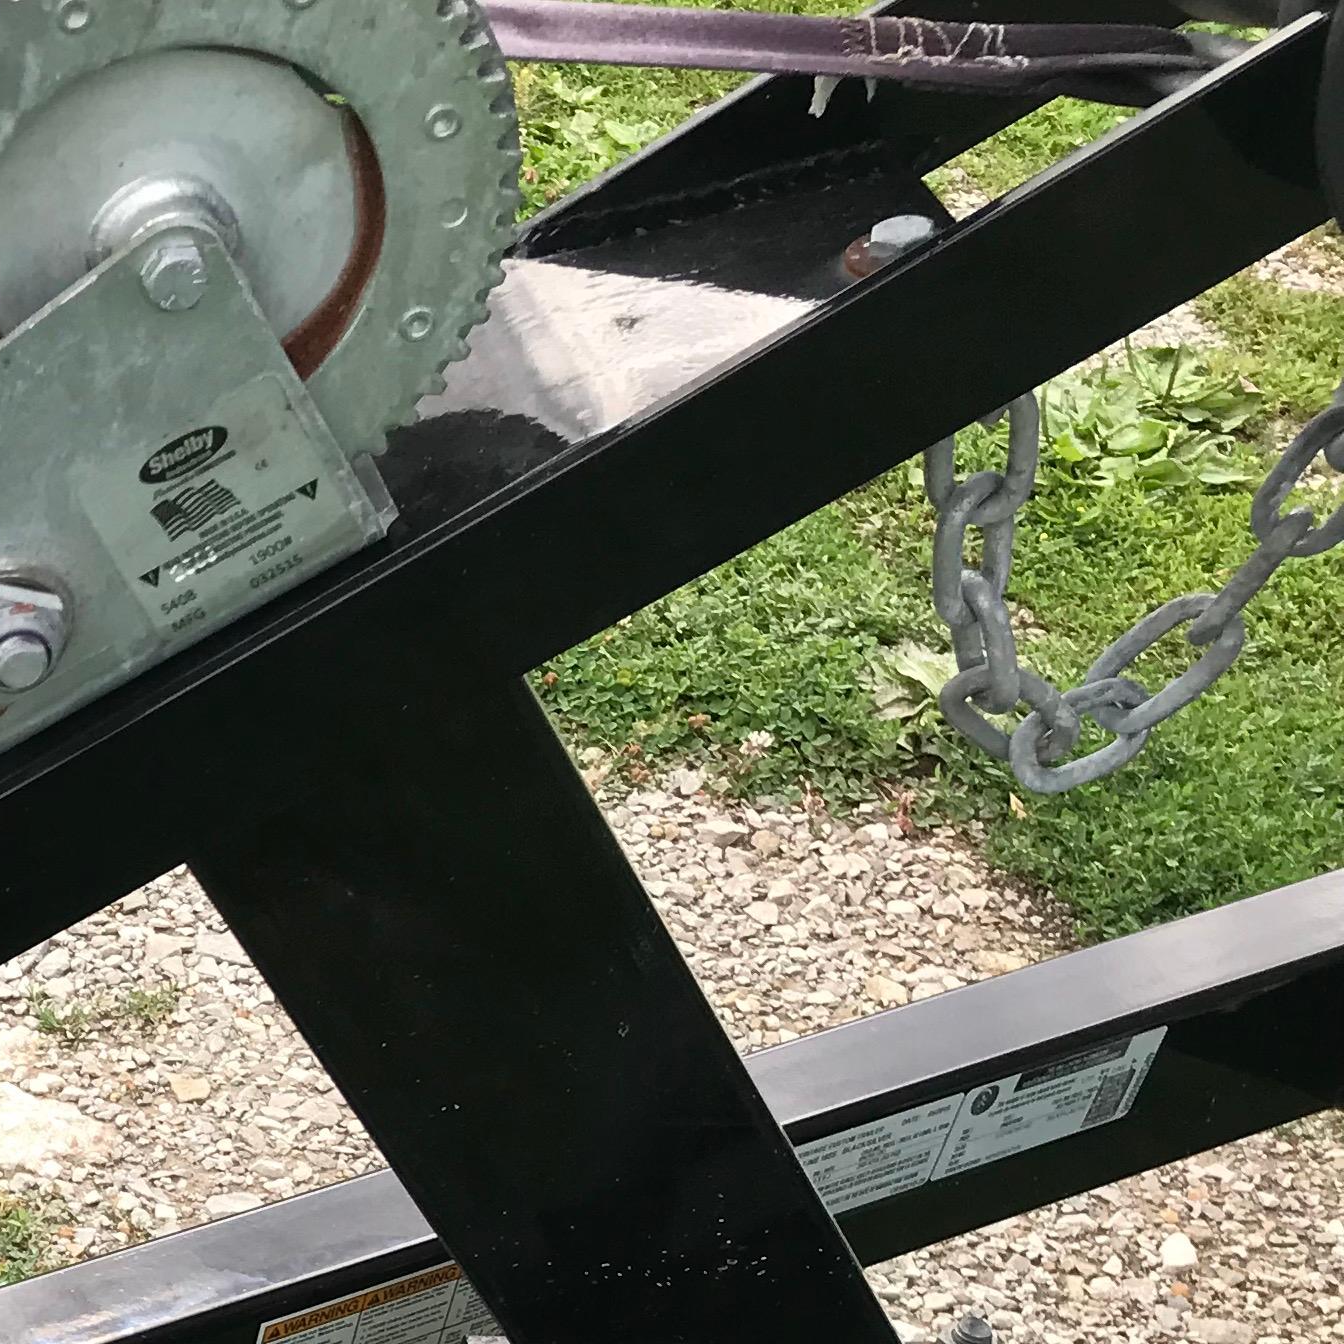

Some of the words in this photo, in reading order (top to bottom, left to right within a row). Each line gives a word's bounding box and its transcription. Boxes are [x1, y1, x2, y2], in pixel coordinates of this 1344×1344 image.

[151, 430, 213, 475] Shelby
[381, 1266, 459, 1300] WARNING
[282, 1299, 362, 1335] WARNING
